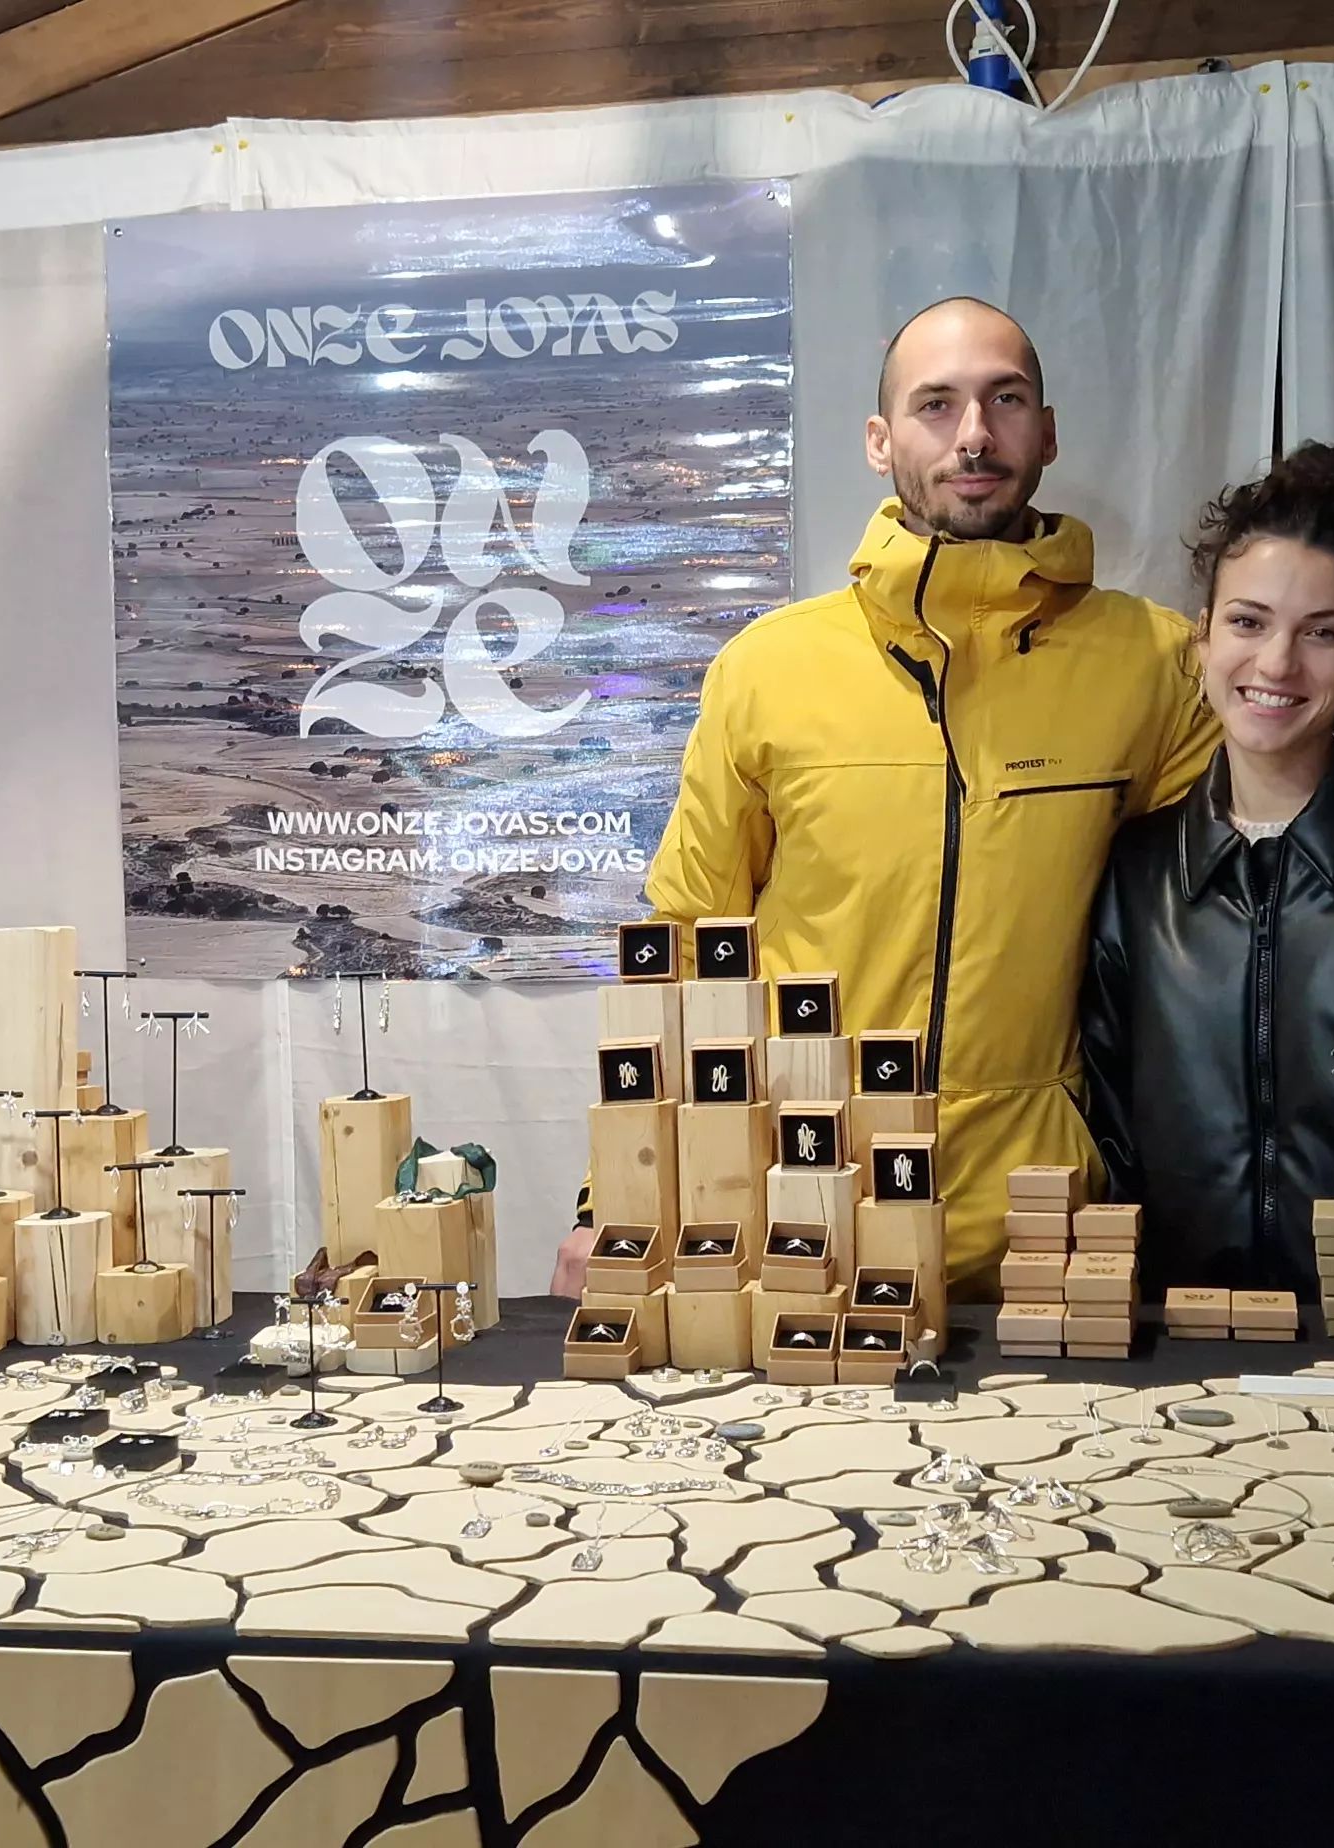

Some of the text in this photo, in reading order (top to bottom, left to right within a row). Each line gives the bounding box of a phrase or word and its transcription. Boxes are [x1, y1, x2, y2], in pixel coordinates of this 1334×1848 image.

[440, 289, 680, 363] JOYAS
[1005, 758, 1045, 772] PROTEST
[267, 811, 631, 836] WWW.ONZEJOYAS.COM
[256, 847, 647, 873] INSTAGRAM: ONZEJOYAS
